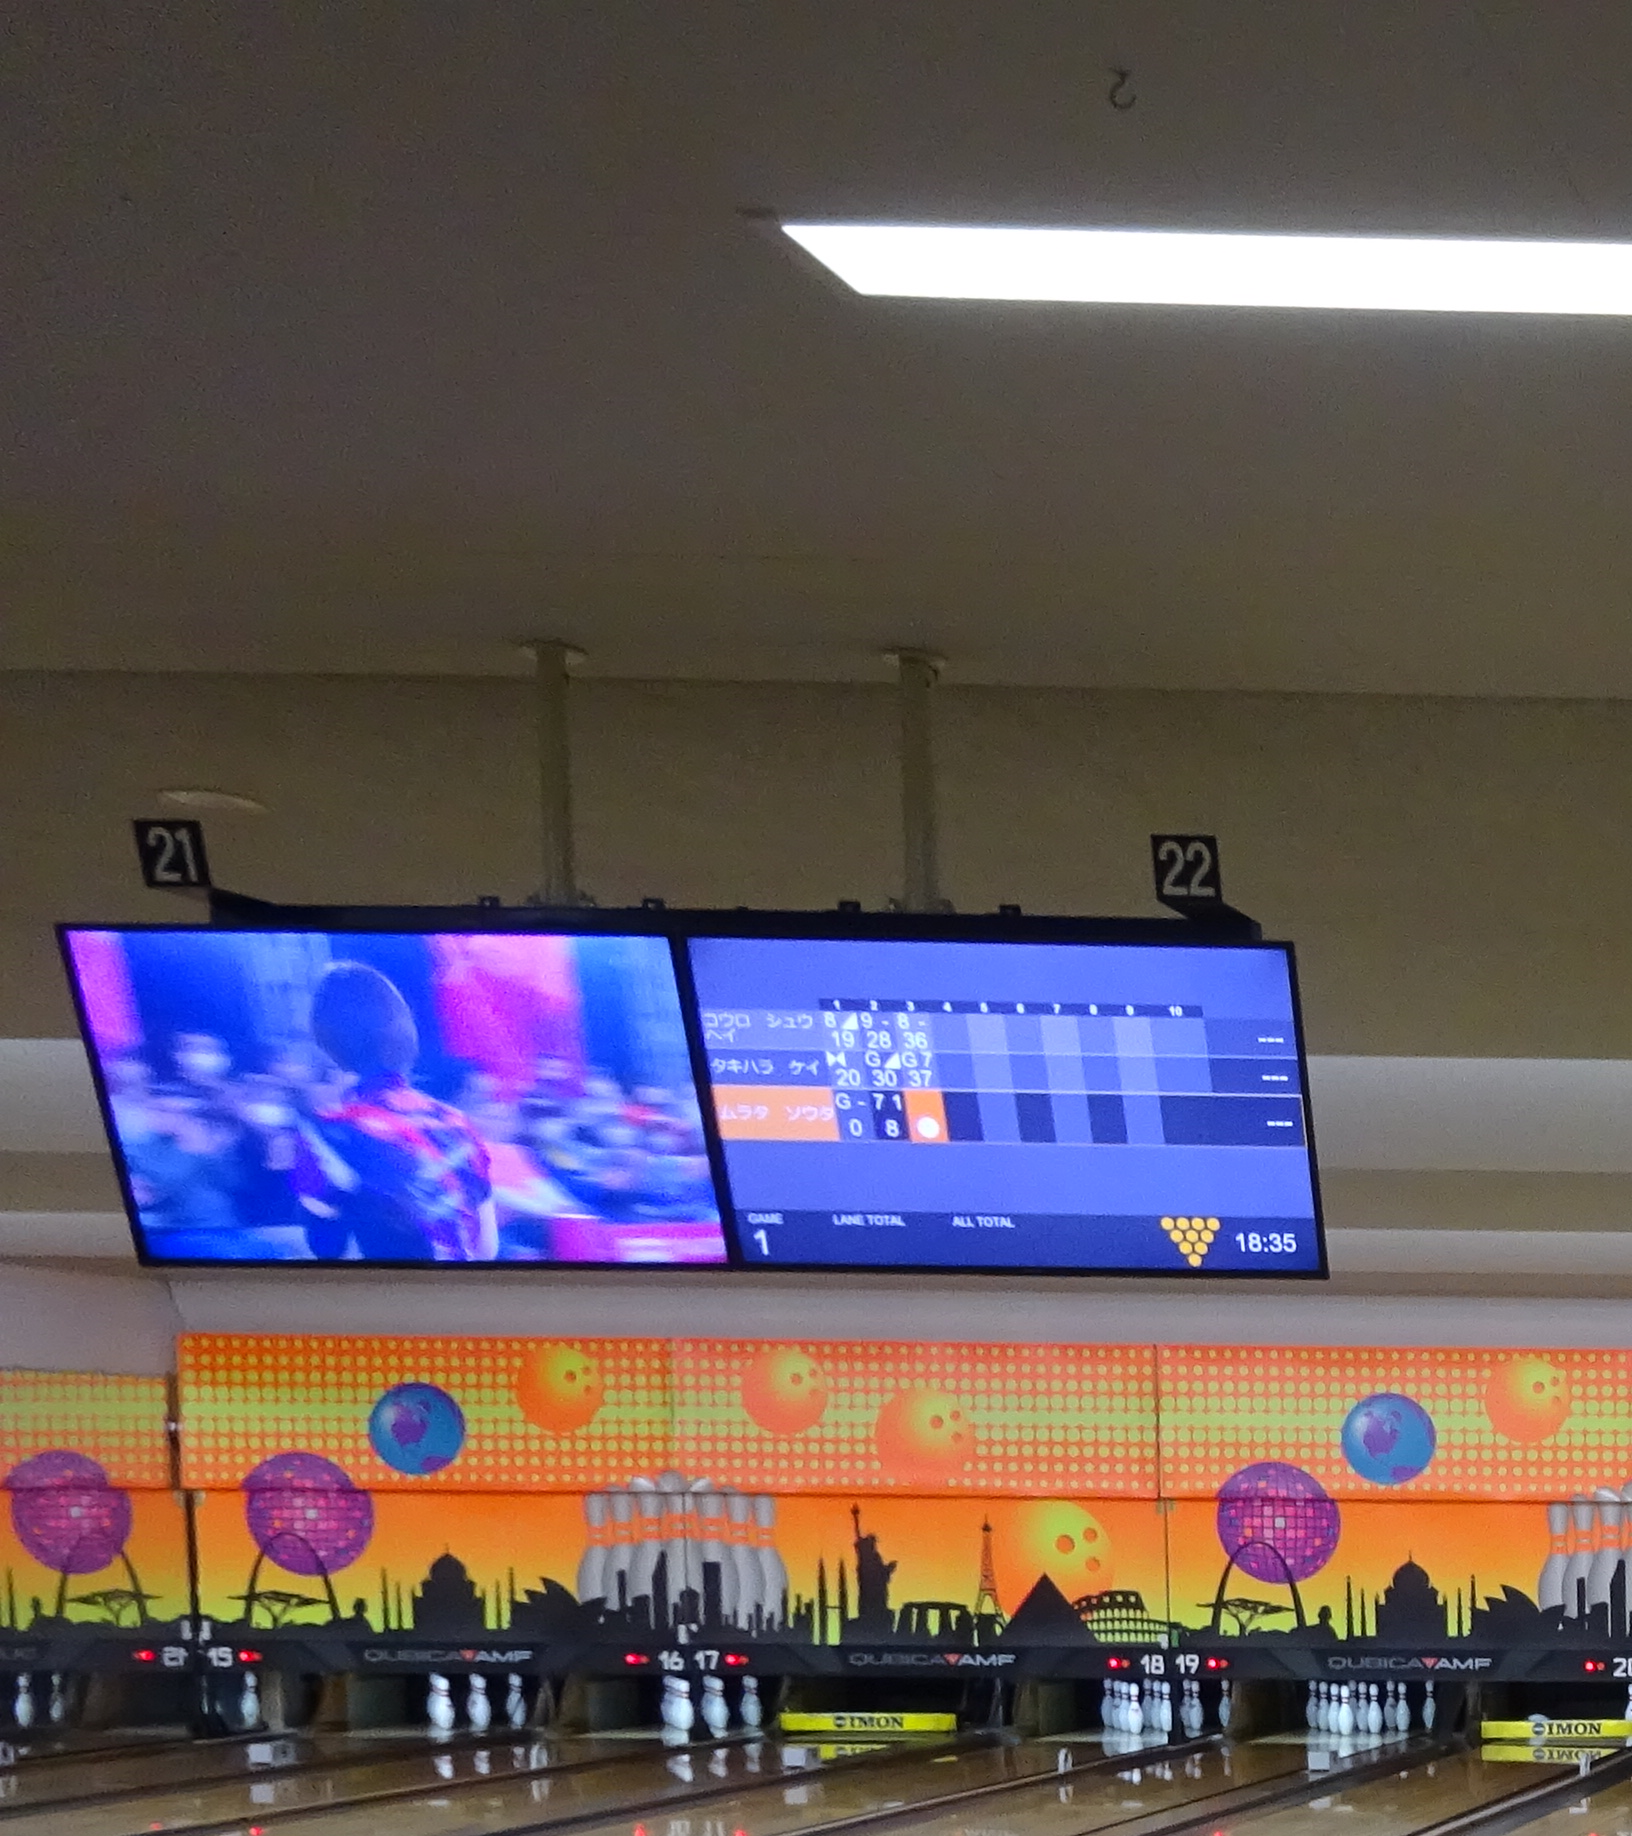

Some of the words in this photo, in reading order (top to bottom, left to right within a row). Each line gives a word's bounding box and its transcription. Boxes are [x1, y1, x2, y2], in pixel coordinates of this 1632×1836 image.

[146, 826, 196, 884] 21
[1158, 840, 1216, 897] 22
[704, 1012, 751, 1028] コウロ
[824, 1012, 836, 1027] 8
[832, 1031, 855, 1048] 19
[866, 1031, 892, 1049] 28
[903, 1032, 928, 1049] 36
[710, 1057, 774, 1075] タキハラ
[835, 1068, 861, 1086] 20
[872, 1069, 897, 1087] 30
[909, 1069, 932, 1087] 37
[850, 1118, 863, 1137] 0
[885, 1119, 900, 1137] 8
[747, 1212, 784, 1224] GAME
[833, 1214, 865, 1226] LANE
[867, 1215, 906, 1227] TOTAL
[952, 1216, 975, 1228] ALL
[977, 1217, 1015, 1228] TOTAL
[753, 1229, 769, 1256] 1
[1235, 1232, 1297, 1253] 18:35
[657, 1649, 684, 1672] 16
[694, 1650, 720, 1672] 17
[1141, 1655, 1165, 1675] 18
[1175, 1655, 1199, 1675] 19
[1547, 1722, 1602, 1736] IMON
